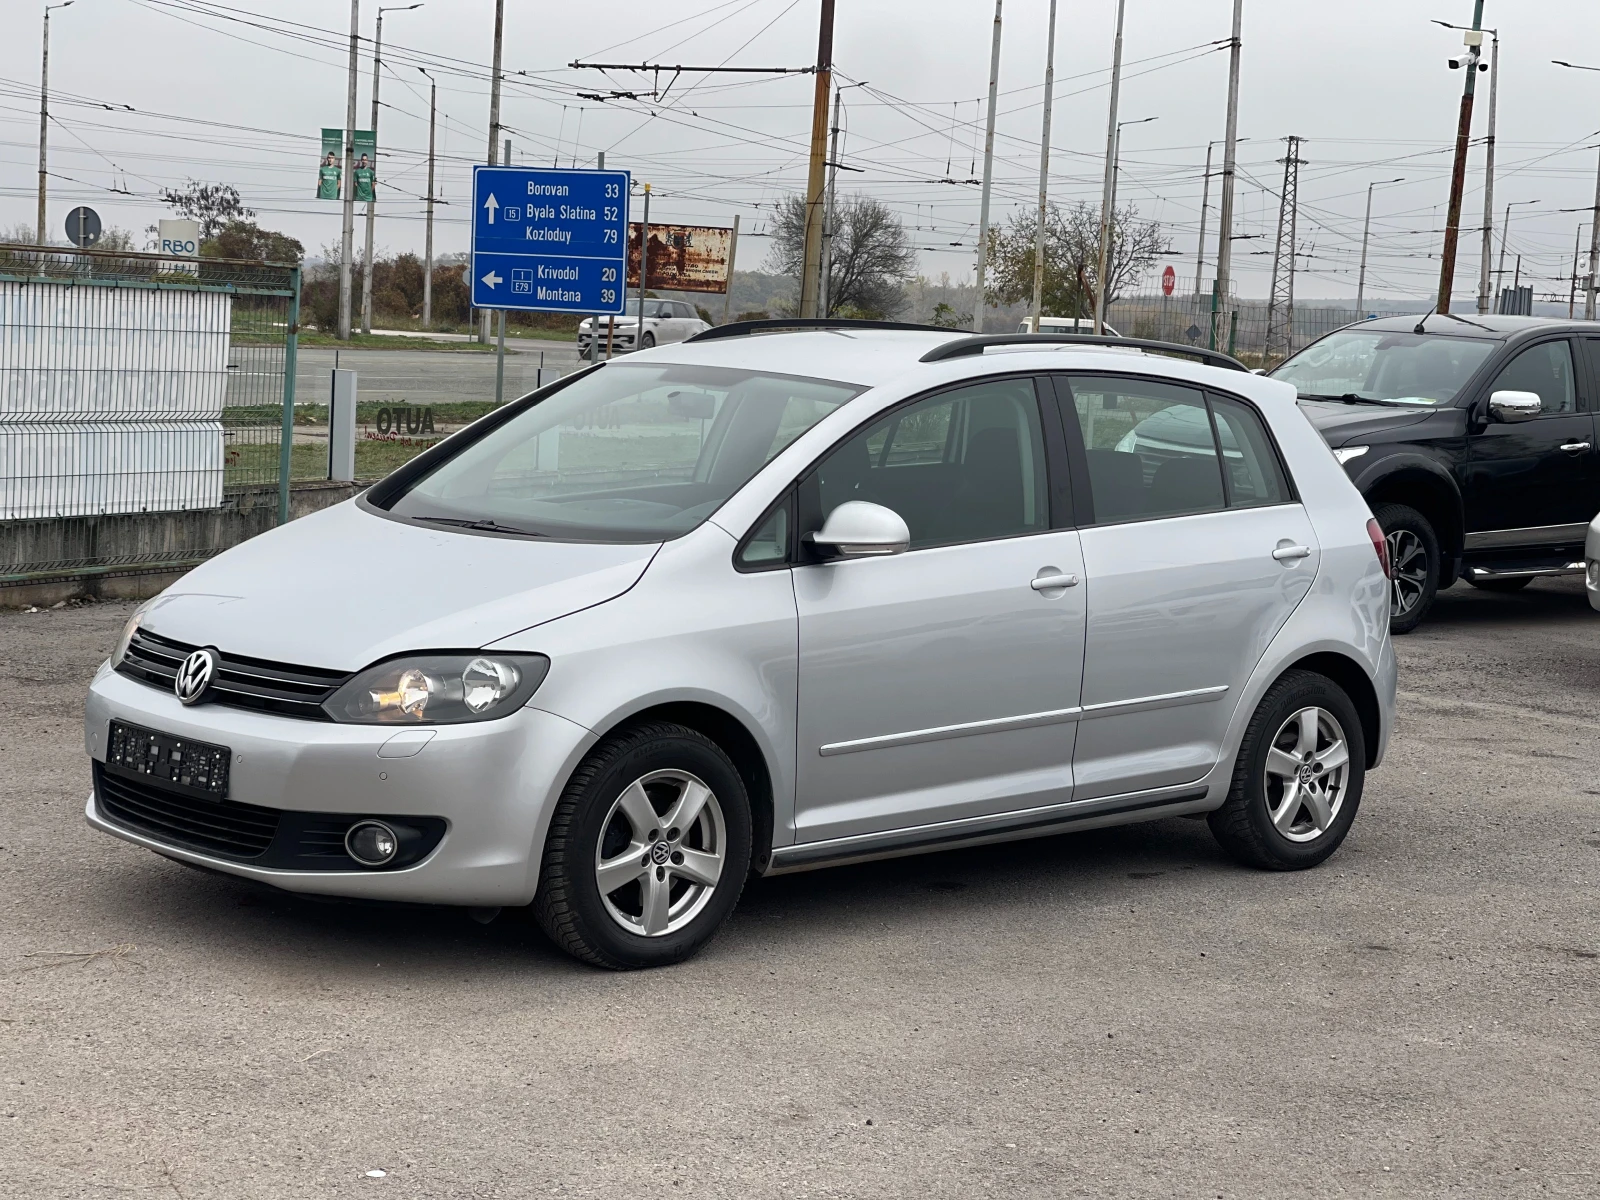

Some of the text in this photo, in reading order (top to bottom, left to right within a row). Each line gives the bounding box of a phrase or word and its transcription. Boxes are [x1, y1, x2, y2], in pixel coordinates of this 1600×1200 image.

[527, 181, 619, 198] Borovan 33
[508, 209, 517, 219] 15
[526, 204, 618, 221] Byala Slatina 52
[526, 226, 618, 245] Kozloduy 79
[163, 240, 195, 254] RBO
[538, 265, 617, 282] Krivodol 20
[1164, 275, 1175, 286] STOP
[515, 282, 529, 292] E79
[537, 286, 616, 303] Montana 39
